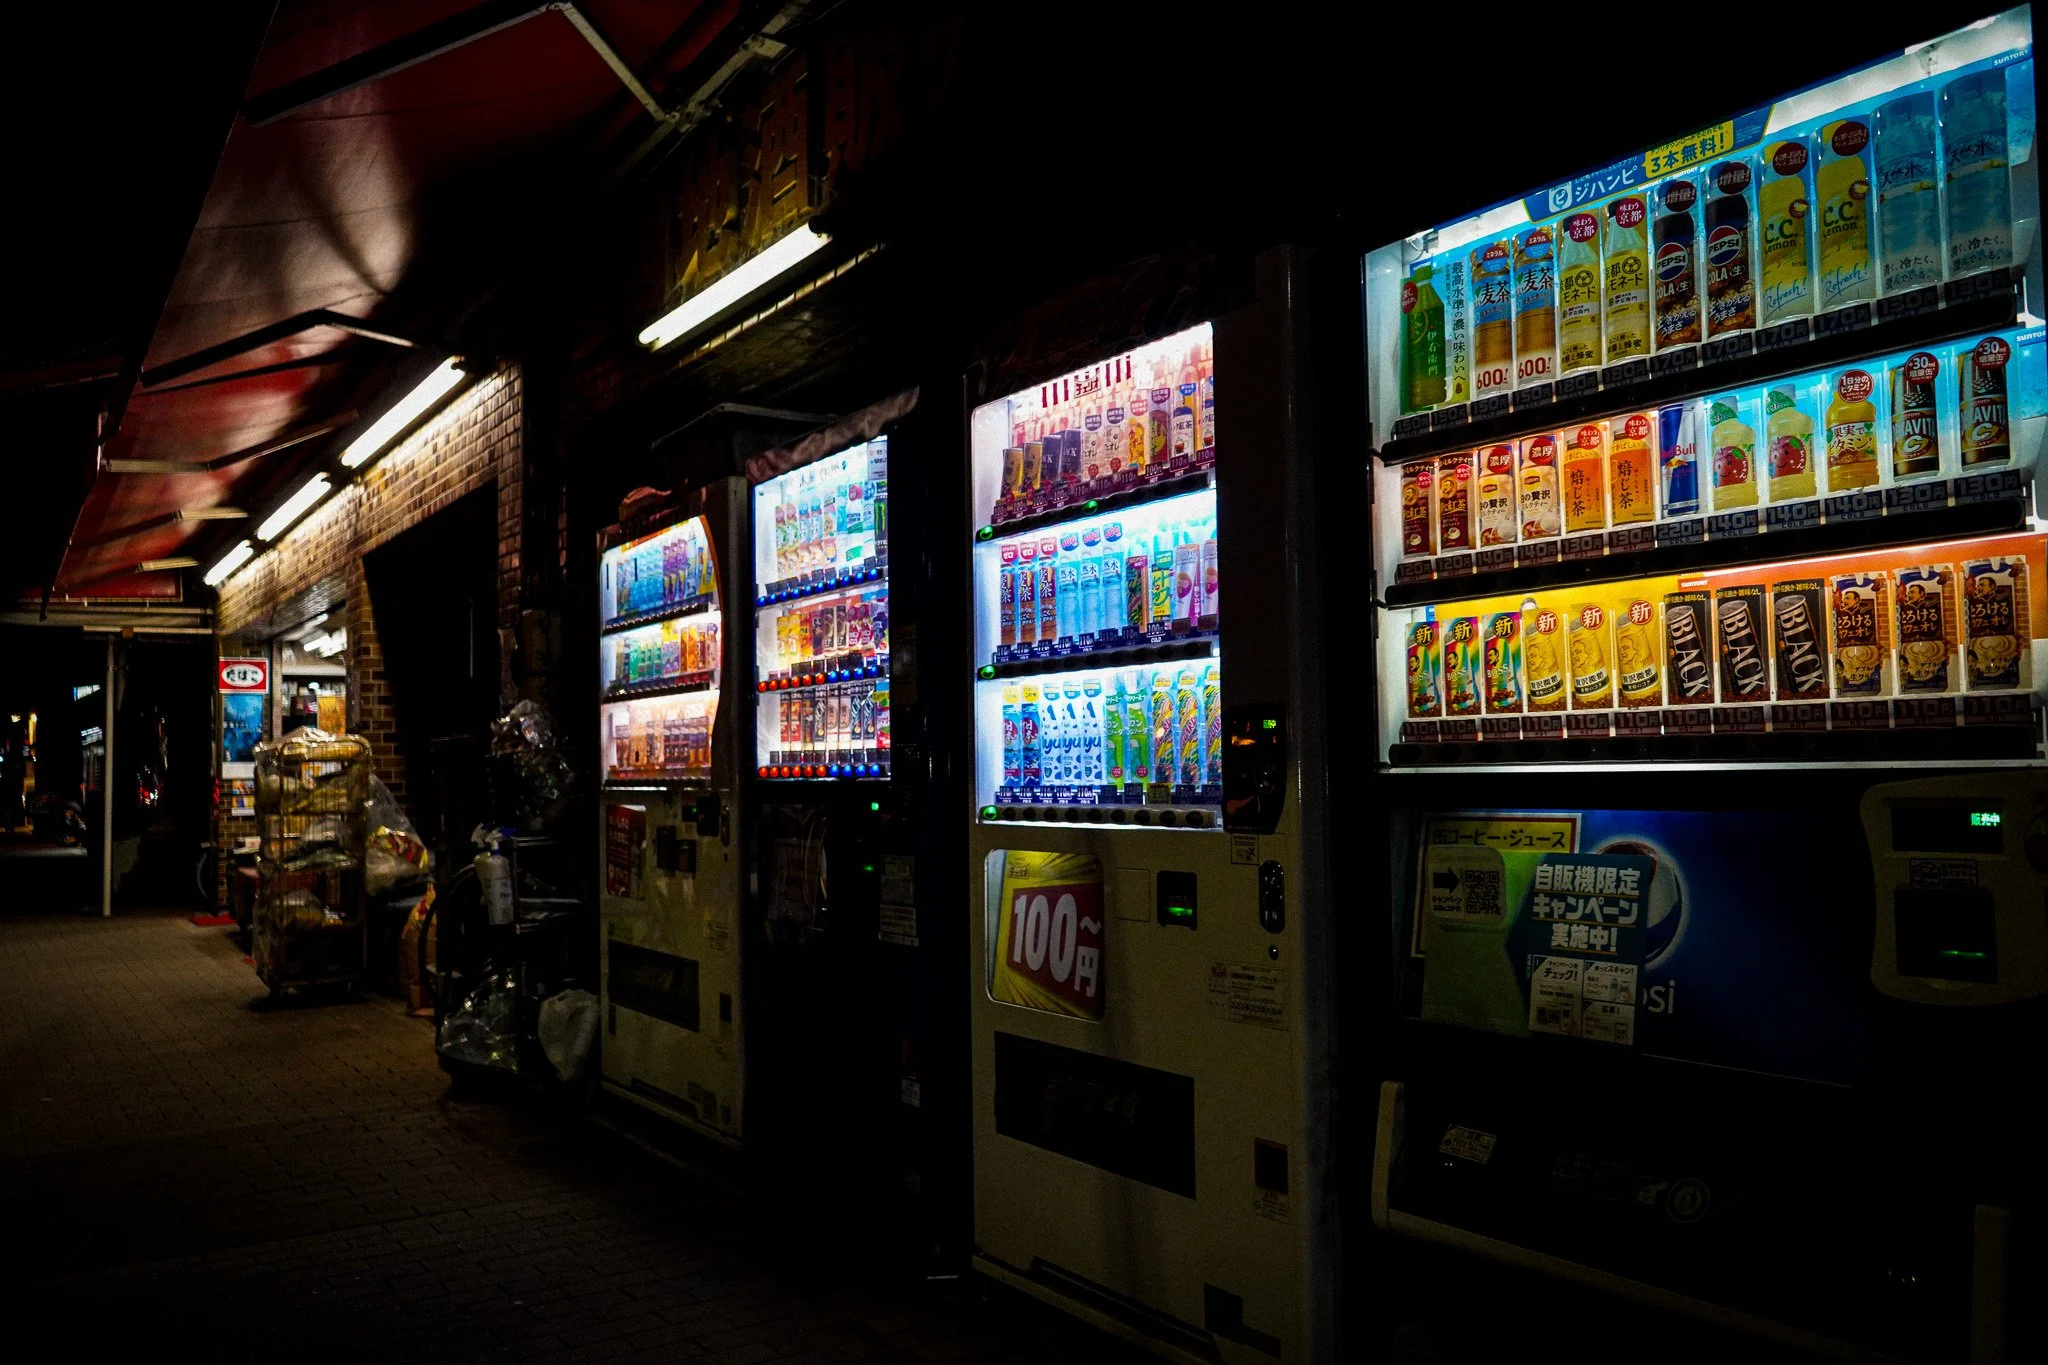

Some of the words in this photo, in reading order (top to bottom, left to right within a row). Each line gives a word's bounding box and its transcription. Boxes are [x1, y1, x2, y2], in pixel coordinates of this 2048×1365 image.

[1650, 132, 1726, 173] 3本無料!
[1574, 164, 1638, 202] ジハンピ
[1719, 169, 1750, 185] 増量!
[1619, 202, 1640, 212] 味わう
[1573, 217, 1592, 227] 味わう
[1619, 209, 1642, 225] 京都
[1573, 224, 1595, 240] 京都
[1708, 238, 1740, 254] PEPSI
[1656, 254, 1687, 271] PEPSI
[1523, 266, 1554, 294] 麦茶
[1480, 280, 1511, 307] 麦茶
[1451, 261, 1467, 381] 最高水準の濃い味わいへ
[1427, 330, 1438, 377] 伊右衛門
[1841, 382, 1871, 394] ビタミン!
[1628, 418, 1647, 427] 味わう
[1628, 426, 1649, 437] 京都
[1580, 436, 1600, 447] 京都
[1675, 443, 1696, 456] Bull
[1531, 445, 1554, 457] 濃厚
[1489, 456, 1511, 467] 濃厚
[1570, 468, 1586, 518] 焙じ茶
[1617, 459, 1634, 510] 焙じ茶
[1583, 607, 1602, 627] 新
[1631, 602, 1650, 622] 新
[1454, 622, 1472, 640] 新
[1495, 618, 1513, 635] 新
[1537, 613, 1556, 632] 新
[1415, 626, 1433, 644] 新
[1670, 615, 1711, 697] BLACK
[1722, 610, 1767, 695] BLACK
[1779, 603, 1826, 693] BLACK
[225, 668, 259, 684] たばこ
[1486, 663, 1510, 679] BOSS
[1534, 863, 1641, 896] 自販機限定
[1532, 896, 1639, 926] キャンペーン
[1550, 922, 1618, 953] 実施中!
[1543, 966, 1579, 983] チェック!
